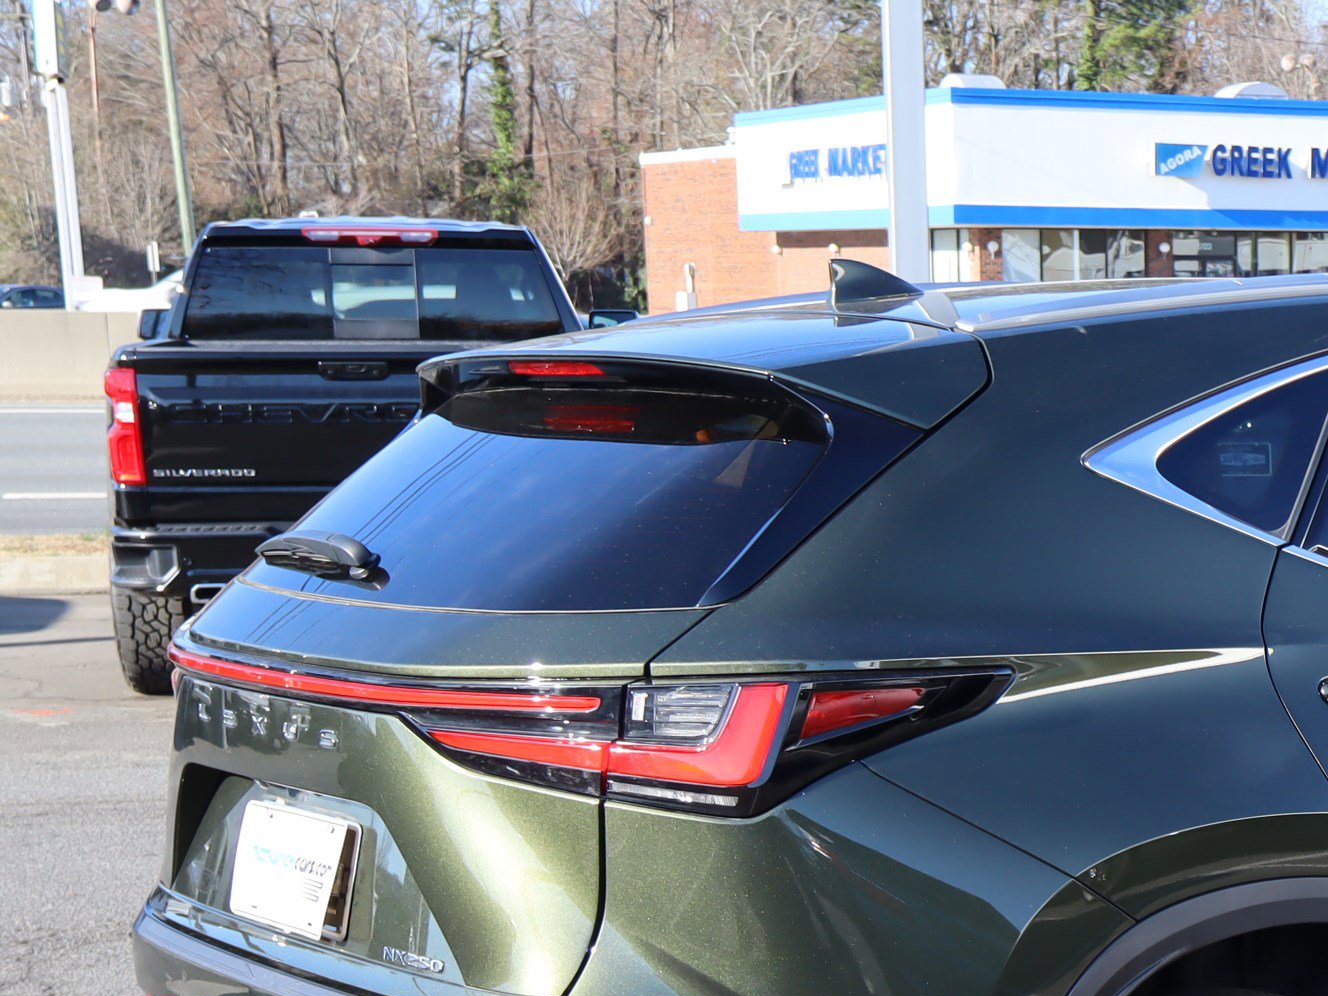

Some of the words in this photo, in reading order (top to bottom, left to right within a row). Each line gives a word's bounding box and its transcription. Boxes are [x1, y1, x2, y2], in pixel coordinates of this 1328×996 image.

[828, 143, 886, 177] MARKE
[1160, 146, 1201, 175] AGORA
[1212, 144, 1292, 179] GREEK
[166, 402, 418, 424] CHEVRO
[152, 467, 257, 478] SILVERADO
[198, 702, 339, 750] LEXUS
